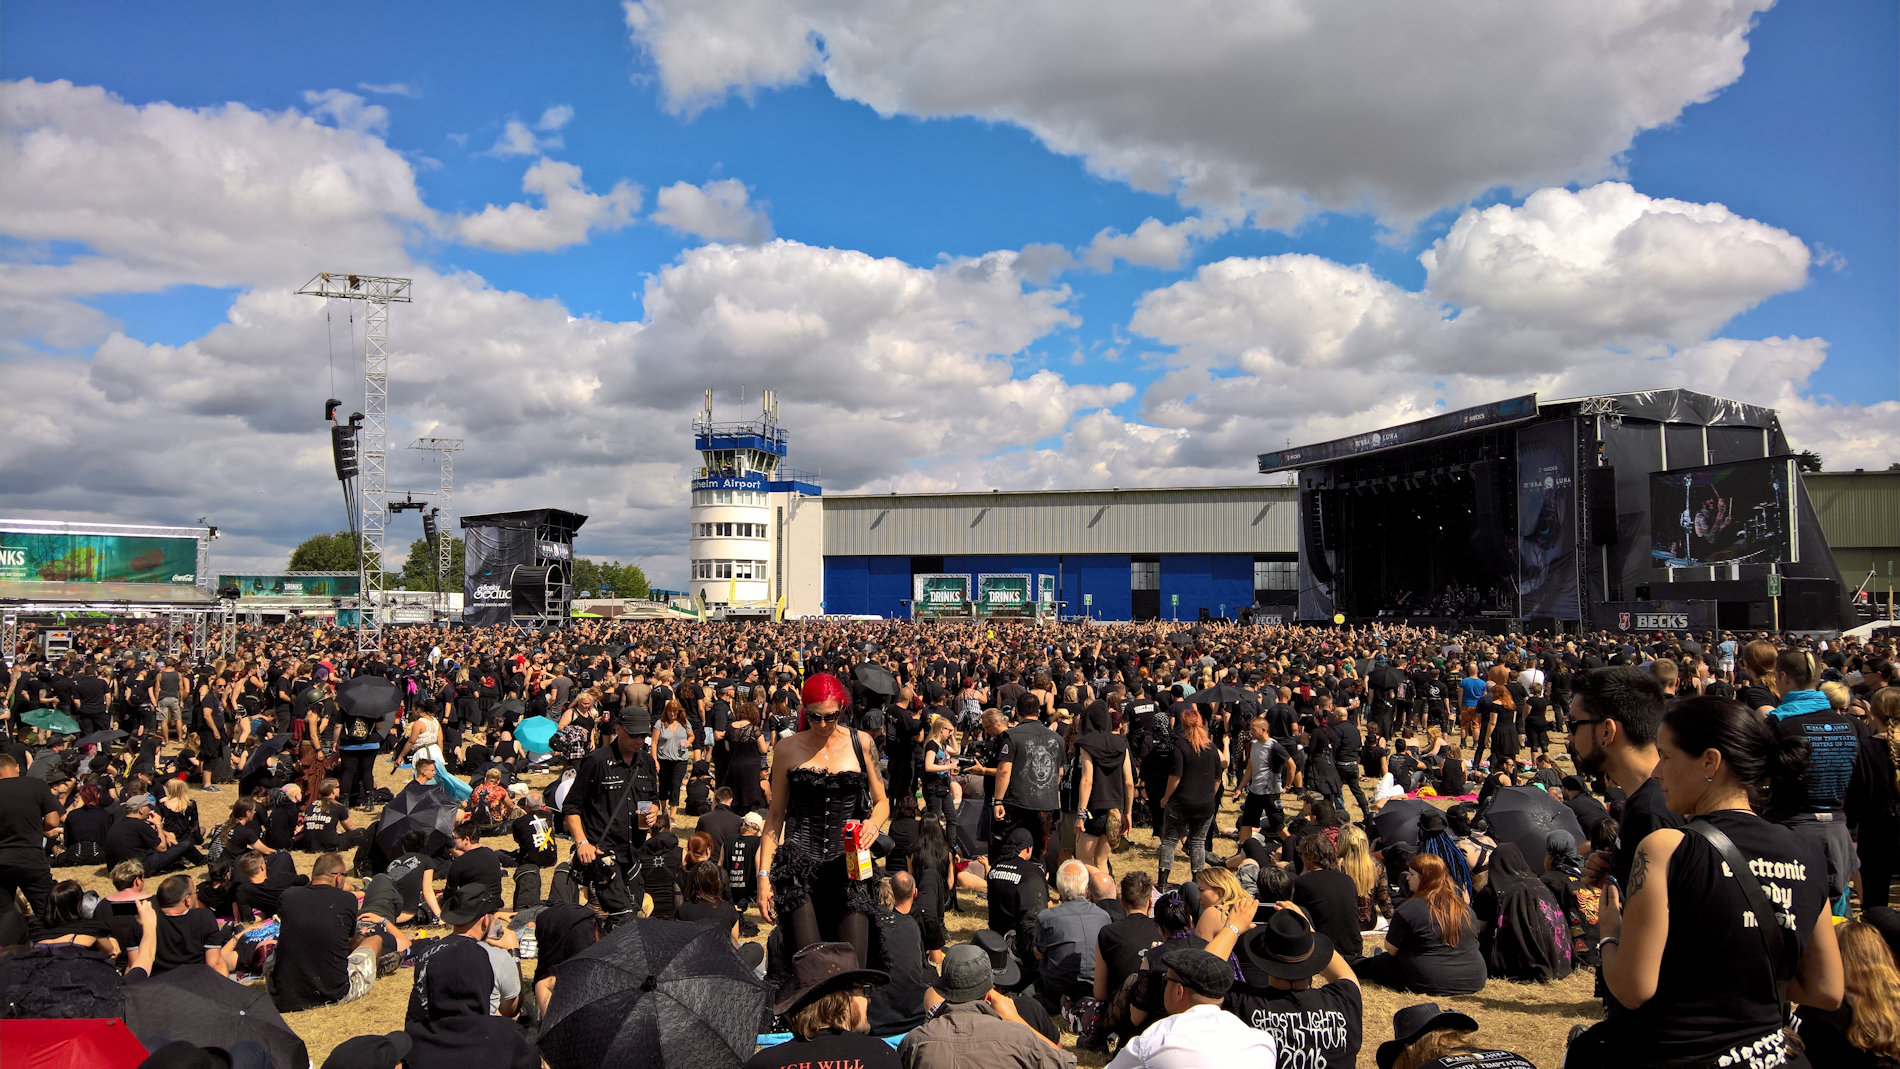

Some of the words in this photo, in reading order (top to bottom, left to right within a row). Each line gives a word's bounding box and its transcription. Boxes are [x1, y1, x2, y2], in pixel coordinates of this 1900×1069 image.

[723, 479, 761, 490] Airport
[930, 591, 961, 602] DRINKS
[989, 591, 1021, 602] DRINKS
[1636, 614, 1689, 628] BECK'S
[989, 869, 1022, 885] Germany
[1721, 857, 1807, 881] ectronic
[1760, 881, 1793, 910] ody
[1743, 908, 1797, 931] msic
[1251, 1009, 1347, 1037] GHOSTLIGHTS
[1310, 1026, 1347, 1053] TOUR
[1280, 1047, 1328, 1069] 2016
